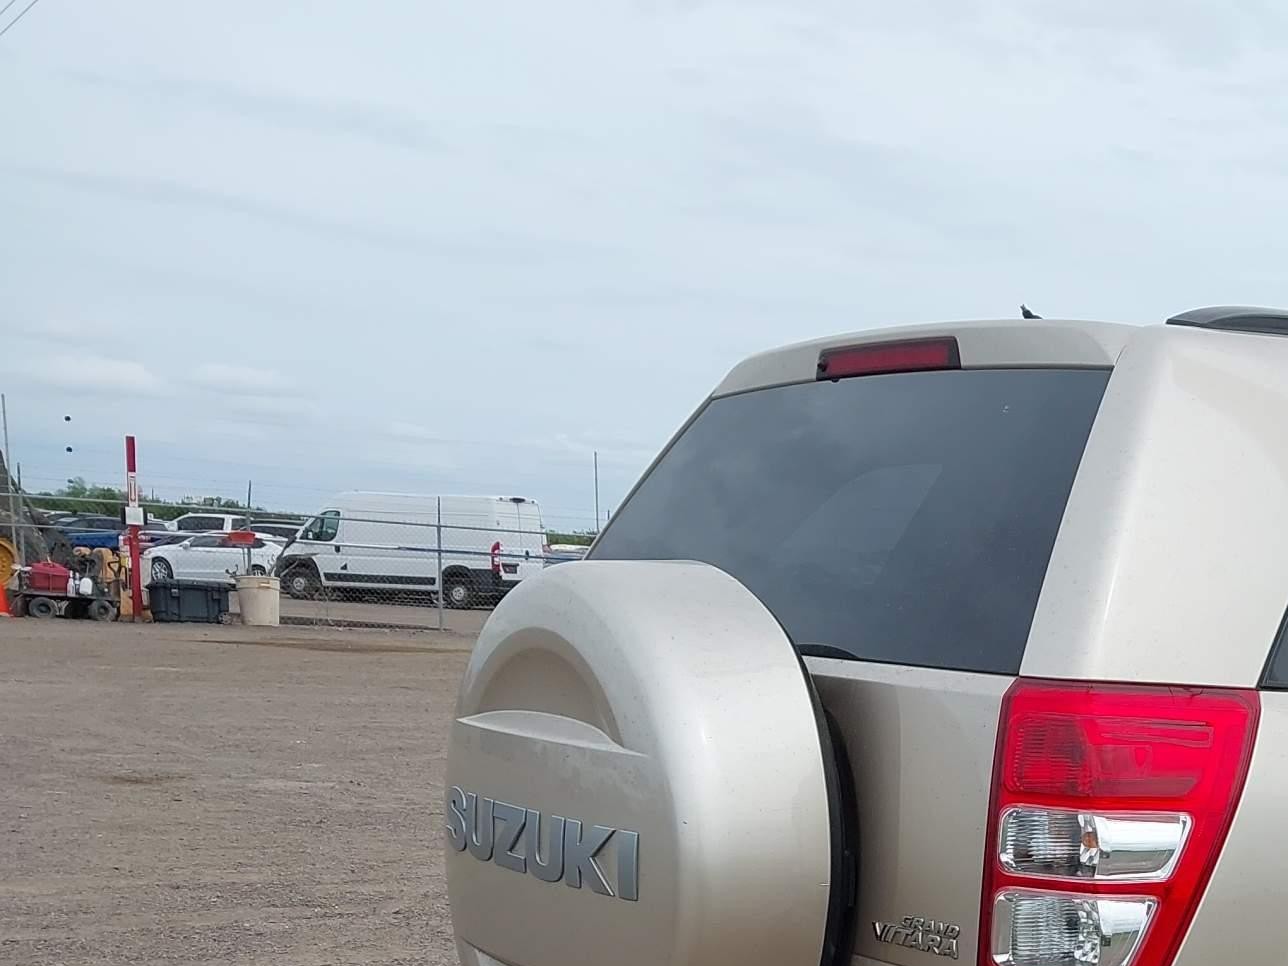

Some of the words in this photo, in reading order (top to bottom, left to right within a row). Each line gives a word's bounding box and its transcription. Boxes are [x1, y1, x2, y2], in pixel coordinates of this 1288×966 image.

[446, 785, 640, 902] SUZUKI
[871, 920, 960, 960] VITARA
[901, 915, 960, 940] GRAND
